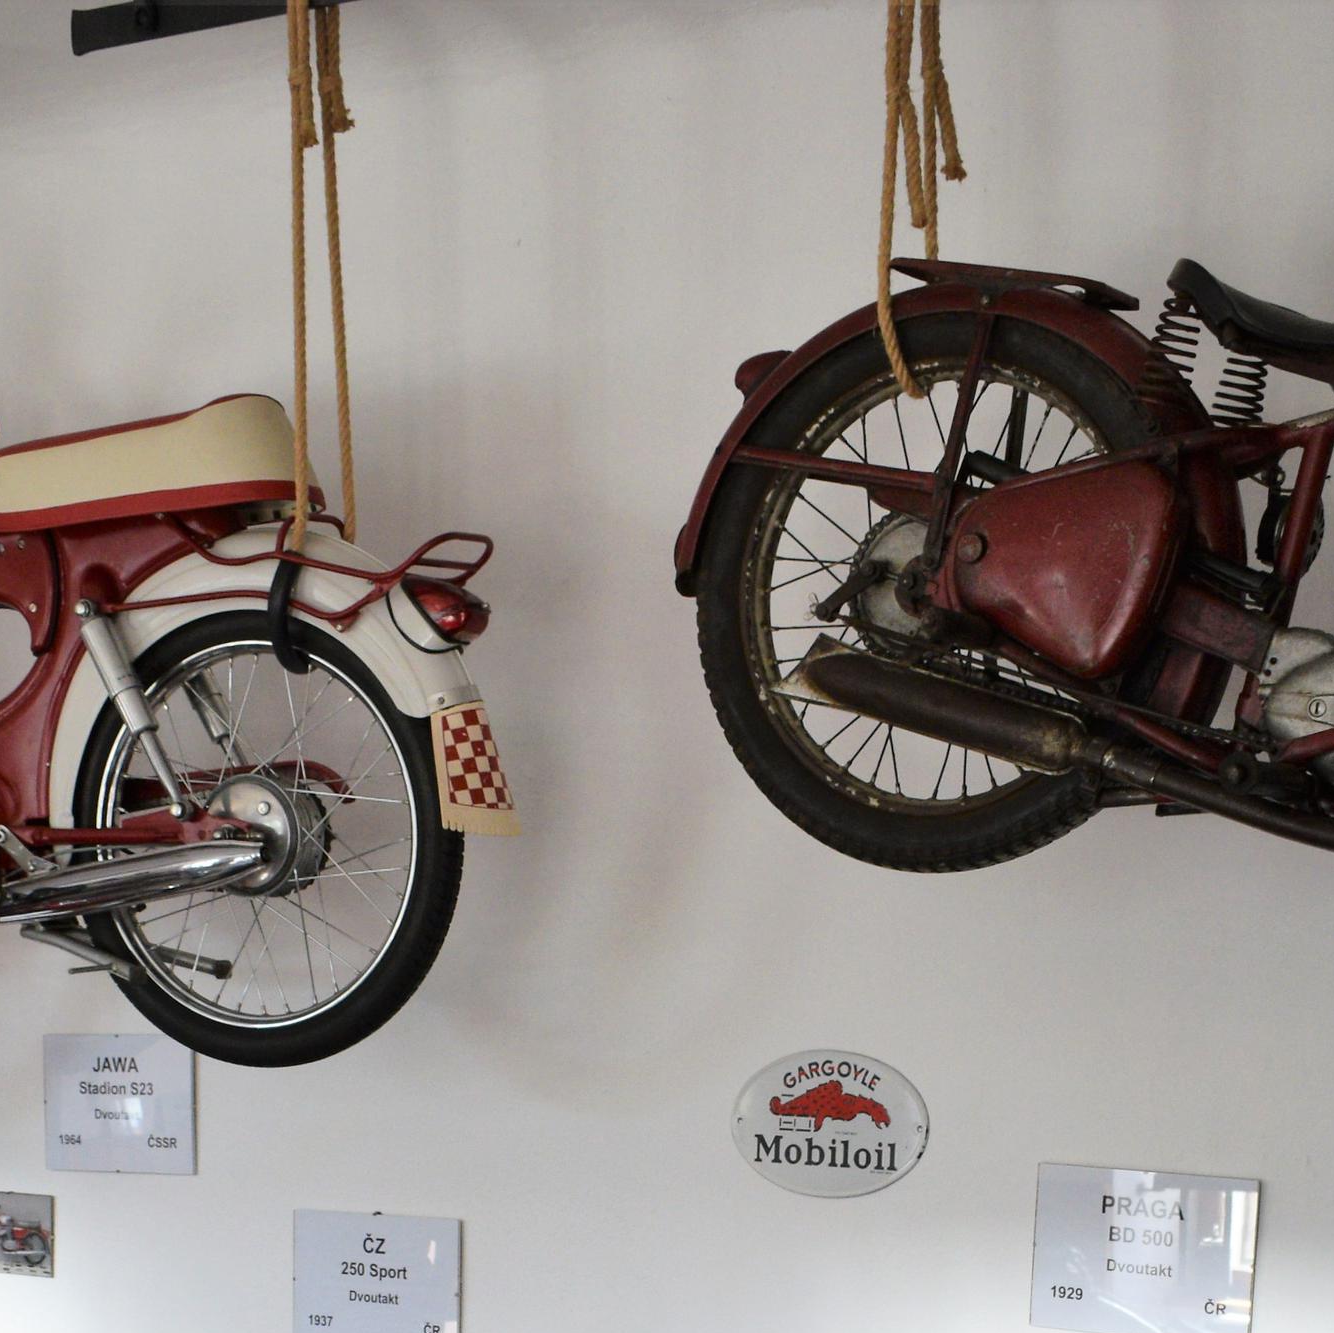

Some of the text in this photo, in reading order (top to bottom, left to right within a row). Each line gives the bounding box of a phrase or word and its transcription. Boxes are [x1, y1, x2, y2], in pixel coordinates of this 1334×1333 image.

[92, 1056, 139, 1073] JAWA
[783, 1059, 881, 1092] GARGOYLE
[79, 1081, 154, 1096] Stadion S23
[58, 1134, 178, 1149] 1964 ČSSR
[754, 1133, 898, 1172] Mobiloil
[1101, 1194, 1185, 1222] PRAGA
[362, 1232, 386, 1255] ČZ
[1108, 1225, 1174, 1248] BD 500
[341, 1261, 408, 1281] 250 Sport
[1106, 1258, 1173, 1279] Dvoutakt
[348, 1289, 399, 1305] Dvoutakt
[1050, 1284, 1084, 1302] 1929
[308, 1314, 334, 1327] 1937
